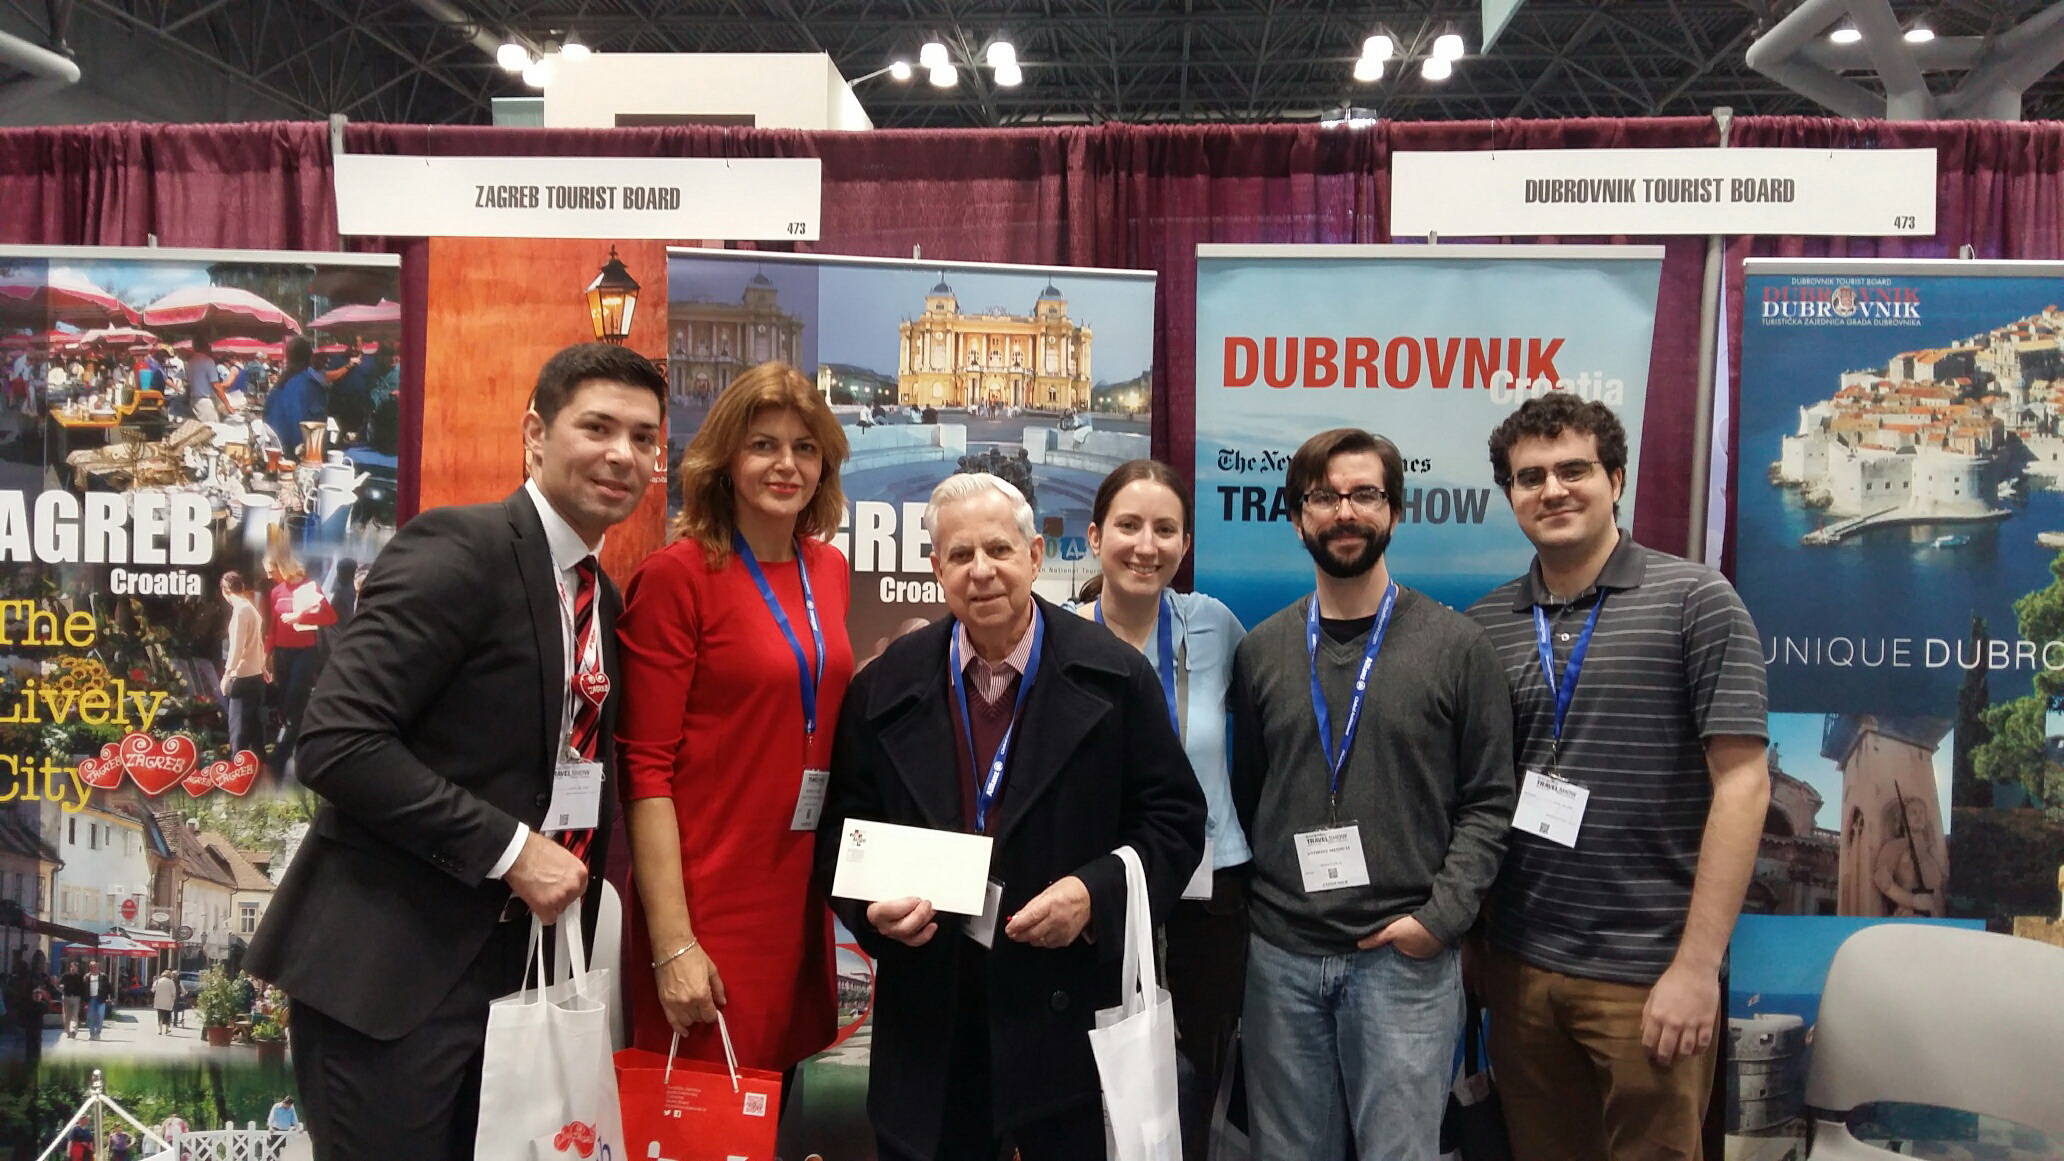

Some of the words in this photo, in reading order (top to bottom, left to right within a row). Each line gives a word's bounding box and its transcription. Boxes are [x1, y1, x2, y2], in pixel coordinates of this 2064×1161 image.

[475, 185, 539, 208] ZAGREB
[545, 186, 617, 210] TOURIST
[622, 187, 681, 211] BOARD
[1525, 178, 1636, 204] DUBROVNIK
[1643, 178, 1725, 204] TOURIST
[1731, 179, 1795, 203] BOARD
[787, 222, 806, 235] 473
[1893, 216, 1916, 230] 473
[1791, 277, 1833, 286] DUBROVNIK
[1836, 277, 1864, 286] TOURIST
[1867, 277, 1892, 286] BOARD
[1223, 336, 1565, 390] DUBROVNIK
[1490, 369, 1624, 405] Croatia
[1218, 448, 1257, 474] The
[1217, 486, 1292, 522] TRA
[1398, 487, 1491, 524] HOW
[0, 490, 213, 565] AGREB
[110, 568, 201, 595] Croatia
[880, 576, 946, 603] Croat
[0, 599, 96, 647] The
[1925, 638, 2064, 671] DUBRO
[1360, 656, 1373, 681] Allianz
[126, 752, 185, 774] ZAGREB
[215, 763, 254, 787] ZAGREB
[986, 770, 1000, 797] Allianz
